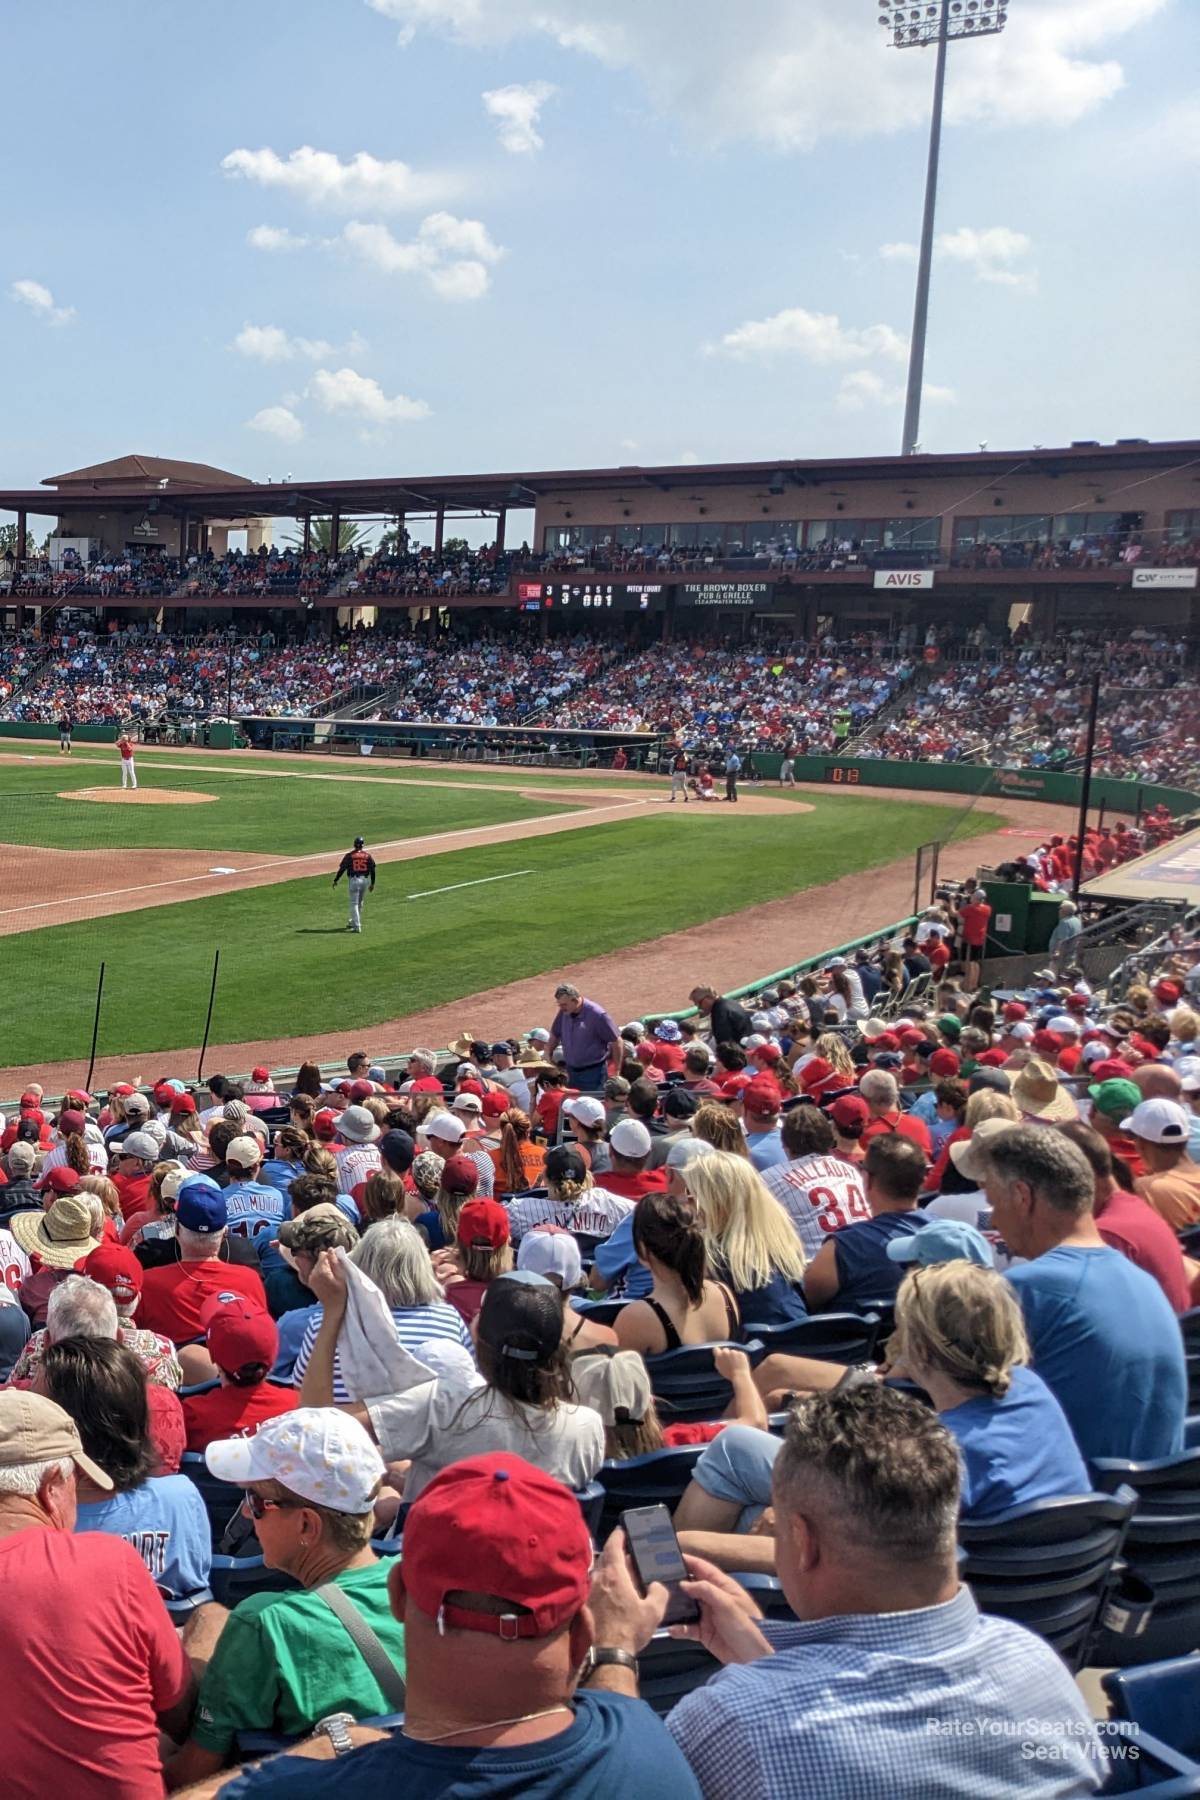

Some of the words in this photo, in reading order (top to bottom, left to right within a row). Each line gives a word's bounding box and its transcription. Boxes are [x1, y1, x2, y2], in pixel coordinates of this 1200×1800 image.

[886, 573, 922, 585] AVIS
[546, 585, 552, 595] 3
[685, 584, 700, 592] THE
[703, 584, 735, 592] BROWN
[737, 584, 767, 592] BOXER
[562, 592, 569, 604] 3
[583, 595, 591, 606] 0
[594, 595, 602, 606] 0
[606, 595, 612, 606] 1
[640, 593, 648, 608] 5
[783, 1160, 857, 1190] HALLADAY
[226, 1193, 282, 1216] EALMUTO
[808, 1183, 872, 1233] 34
